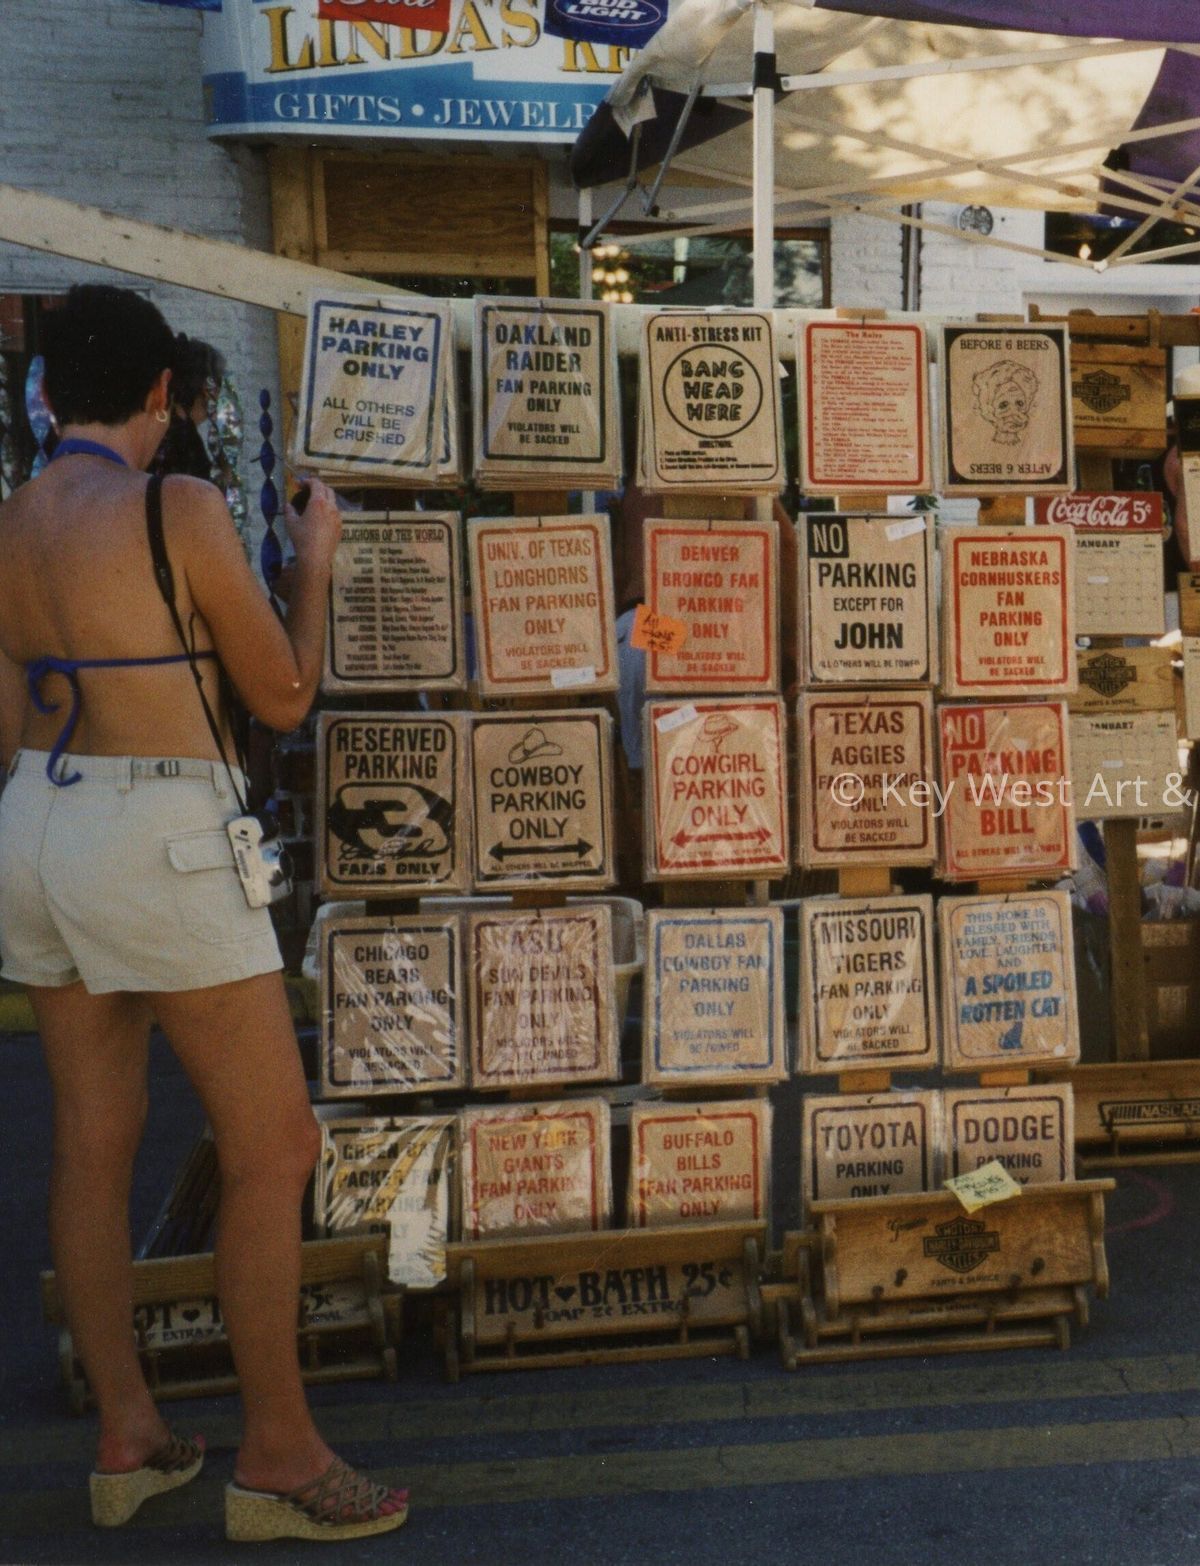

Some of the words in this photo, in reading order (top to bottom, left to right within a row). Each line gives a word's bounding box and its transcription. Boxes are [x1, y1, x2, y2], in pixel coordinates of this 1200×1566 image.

[567, 4, 646, 21] LIGHT
[274, 92, 402, 122] GIFTS
[329, 317, 423, 342] HARLEY
[496, 324, 591, 347] OAKLAND
[656, 326, 739, 343] ANTI-STRESS
[741, 326, 762, 342] KIT
[322, 336, 428, 362] PARKING
[960, 339, 1001, 350] BEFORE
[1005, 339, 1012, 350] 6
[1016, 339, 1050, 351] BEERS
[343, 360, 405, 380] ONLY
[507, 350, 582, 372] RAIDER
[681, 359, 744, 378] BANG
[496, 379, 524, 394] FAN
[530, 379, 592, 396] PARKING
[683, 381, 744, 400] HEAD
[323, 397, 348, 410] ALL
[355, 400, 415, 417] OTHERS
[527, 398, 561, 413] ONLY
[686, 403, 742, 421] HERE
[341, 413, 375, 428] WILL
[381, 417, 400, 430] BE
[334, 428, 405, 445] CRUSHED
[970, 463, 1001, 475] BEERS
[1016, 463, 1052, 474] AFTER
[813, 522, 843, 552] NO
[487, 542, 524, 561] UNIV.
[528, 540, 546, 557] OF
[550, 538, 591, 557] TEXAS
[680, 545, 739, 563] DENVER
[971, 551, 1048, 567] NEBRASKA
[495, 565, 588, 588] LONGHORNS
[662, 572, 723, 588] BRONCO
[730, 572, 759, 588] FAN
[818, 562, 916, 588] PARKING
[960, 571, 1061, 587] CORNHUSKERS
[489, 597, 520, 613] FAN
[525, 592, 598, 611] PARKING
[677, 597, 744, 613] PARKING
[833, 597, 875, 612] EXCEPT
[880, 597, 903, 611] FOR
[997, 591, 1025, 606] FAN
[524, 618, 566, 635] ONLY
[979, 611, 1043, 627] PARKING
[692, 623, 729, 639] ONLY
[834, 622, 903, 649] JOHN
[994, 632, 1029, 647] ONLY
[829, 712, 904, 735] TEXAS
[948, 714, 979, 745] NO
[336, 727, 446, 753] RESERVED
[671, 754, 765, 776] COWGIRL
[831, 746, 905, 766] AGGIES
[345, 755, 438, 779] PARKING
[490, 765, 584, 788] COWBOY
[673, 777, 765, 801] PARKING
[491, 789, 586, 813] PARKING
[691, 804, 748, 827] ONLY
[831, 819, 884, 830] VIOLATORS
[886, 819, 909, 829] WILL
[981, 808, 1035, 836] BILL
[509, 817, 569, 840] ONLY
[845, 833, 857, 843] BE
[859, 831, 897, 843] SACKED
[396, 862, 440, 875] ONLY
[966, 912, 992, 923] THIS
[822, 916, 916, 945] MISSOURI
[964, 923, 1016, 935] BLESSED
[685, 933, 745, 948] DALLAS
[354, 944, 429, 963] CHICAGO
[832, 950, 906, 974] TIGERS
[998, 958, 1021, 967] AND
[663, 955, 730, 972] COWBOY
[365, 968, 420, 985] BEARS
[680, 977, 749, 993] PARKING
[964, 976, 977, 996] A
[983, 971, 1052, 991] SPOILED
[820, 984, 849, 999] FAN
[854, 978, 922, 998] PARKING
[336, 992, 367, 1009] FAN
[484, 989, 516, 1008] FAN
[694, 1002, 734, 1018] ONLY
[961, 1000, 1024, 1024] ROTTEN
[1031, 998, 1061, 1016] CAT
[371, 1015, 414, 1032] ONLY
[862, 1038, 899, 1050] SACKED
[821, 1121, 918, 1151] TOYOTA
[963, 1115, 1054, 1144] DODGE
[489, 1135, 524, 1150] NEW
[663, 1130, 734, 1150] BUFFALO
[504, 1154, 564, 1173] GIANTS
[677, 1154, 721, 1171] BILLS
[836, 1160, 903, 1178] PARKING
[480, 1182, 511, 1199] FAN
[648, 1180, 676, 1196] FAN
[682, 1173, 751, 1192] PARKING
[851, 1184, 890, 1198] ONLY
[514, 1202, 556, 1219] ONLY
[680, 1201, 720, 1218] ONLY
[484, 1275, 555, 1315] HOT
[578, 1265, 670, 1306] BATH
[682, 1262, 733, 1297] 25¢
